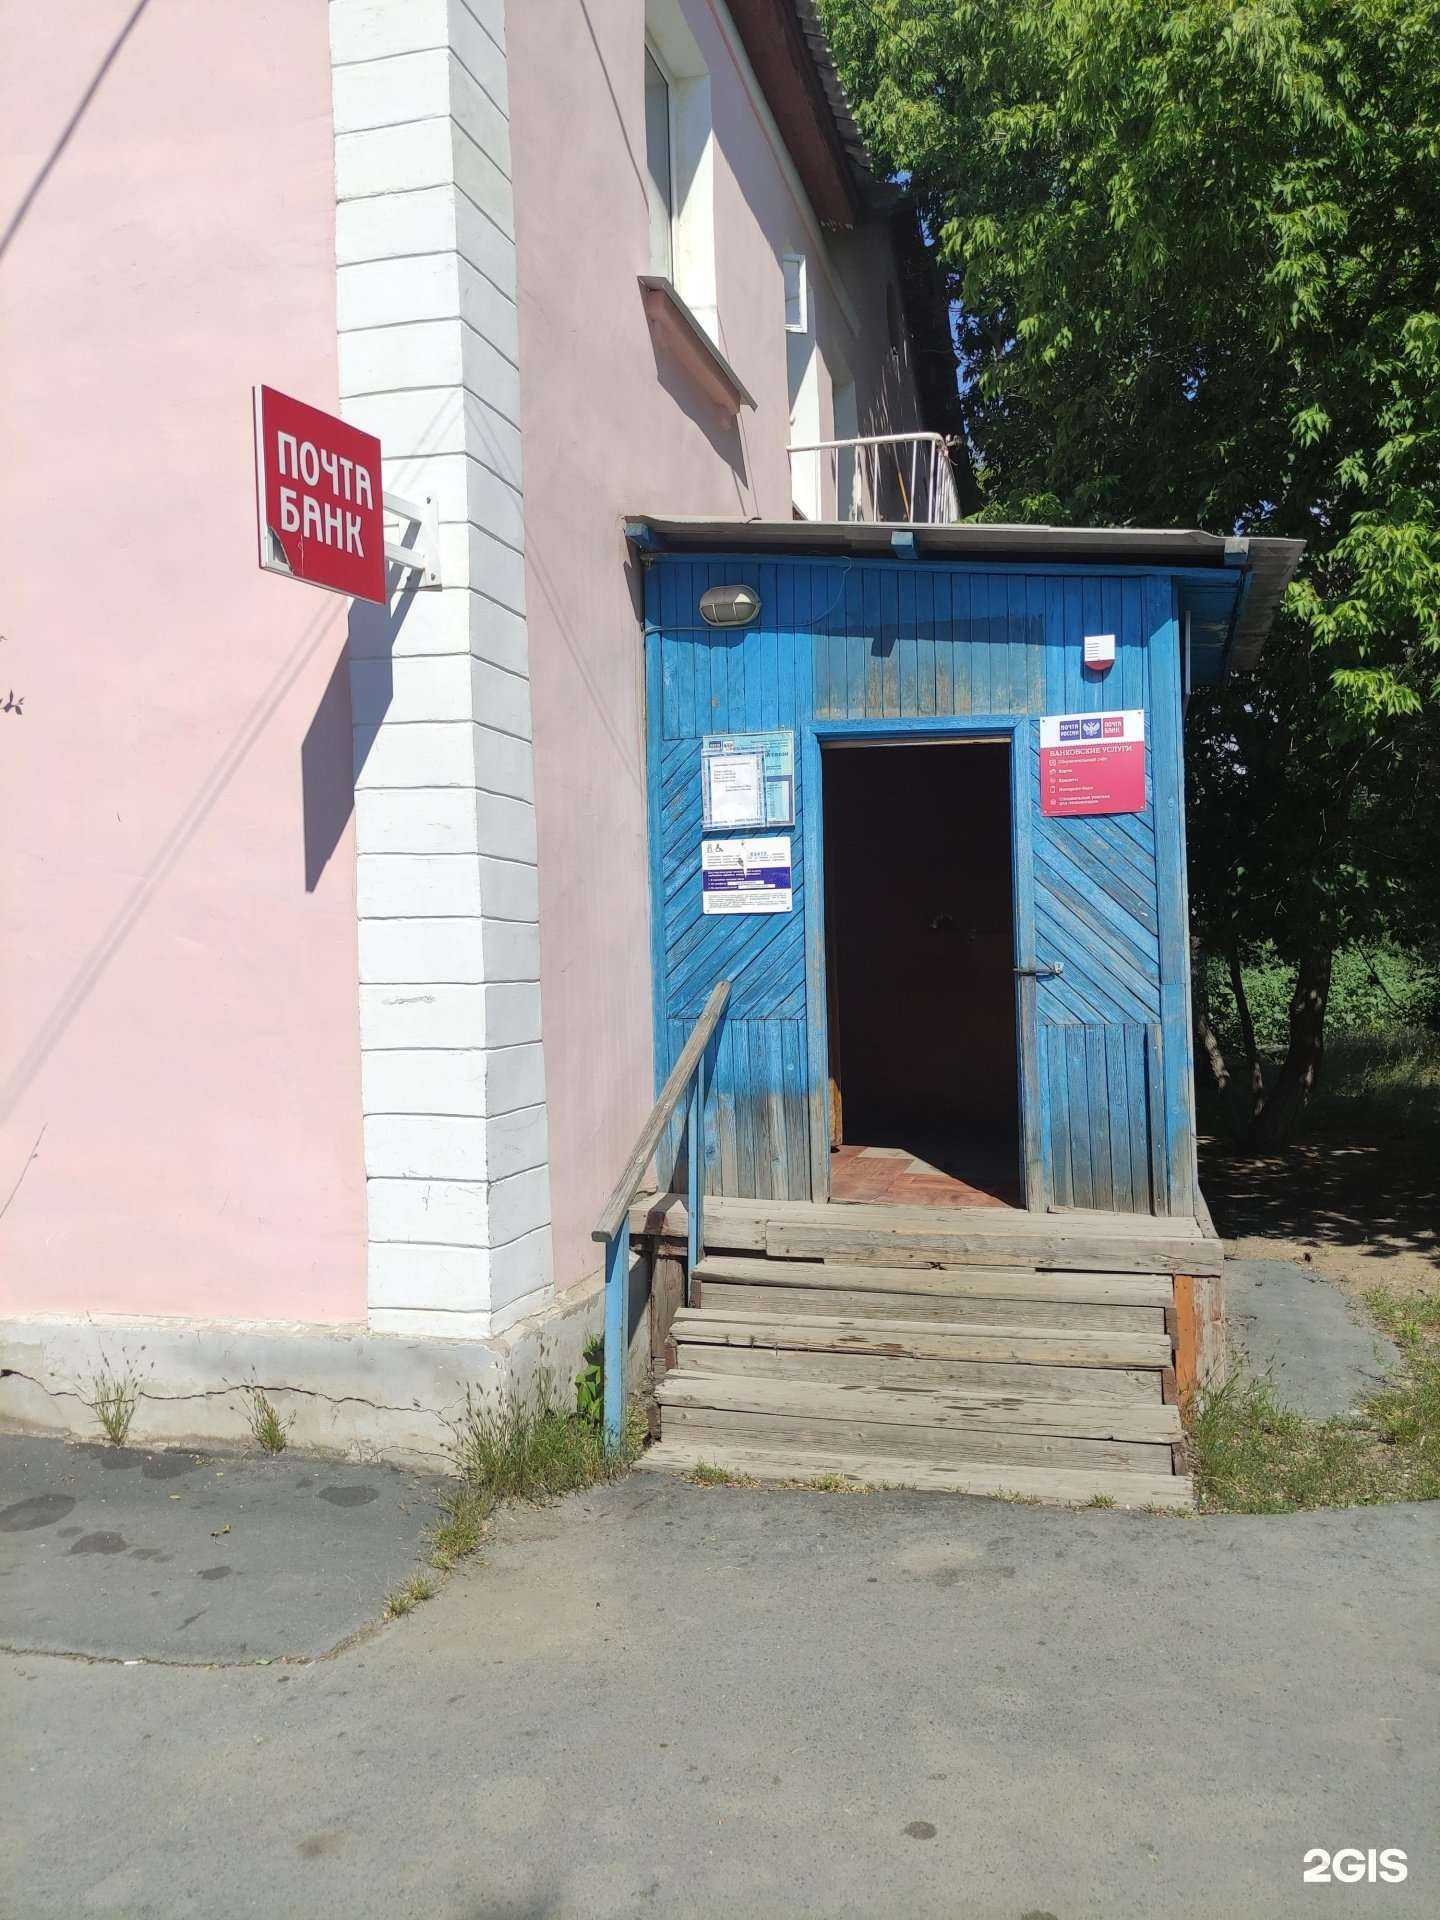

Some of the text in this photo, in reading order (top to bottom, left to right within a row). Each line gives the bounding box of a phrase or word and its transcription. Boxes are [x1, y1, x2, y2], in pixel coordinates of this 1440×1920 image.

[277, 430, 374, 511] ПОЧТА
[279, 486, 365, 558] БАНК
[1049, 745, 1133, 757] БАНКОВСКИЕ УСЛУГИ
